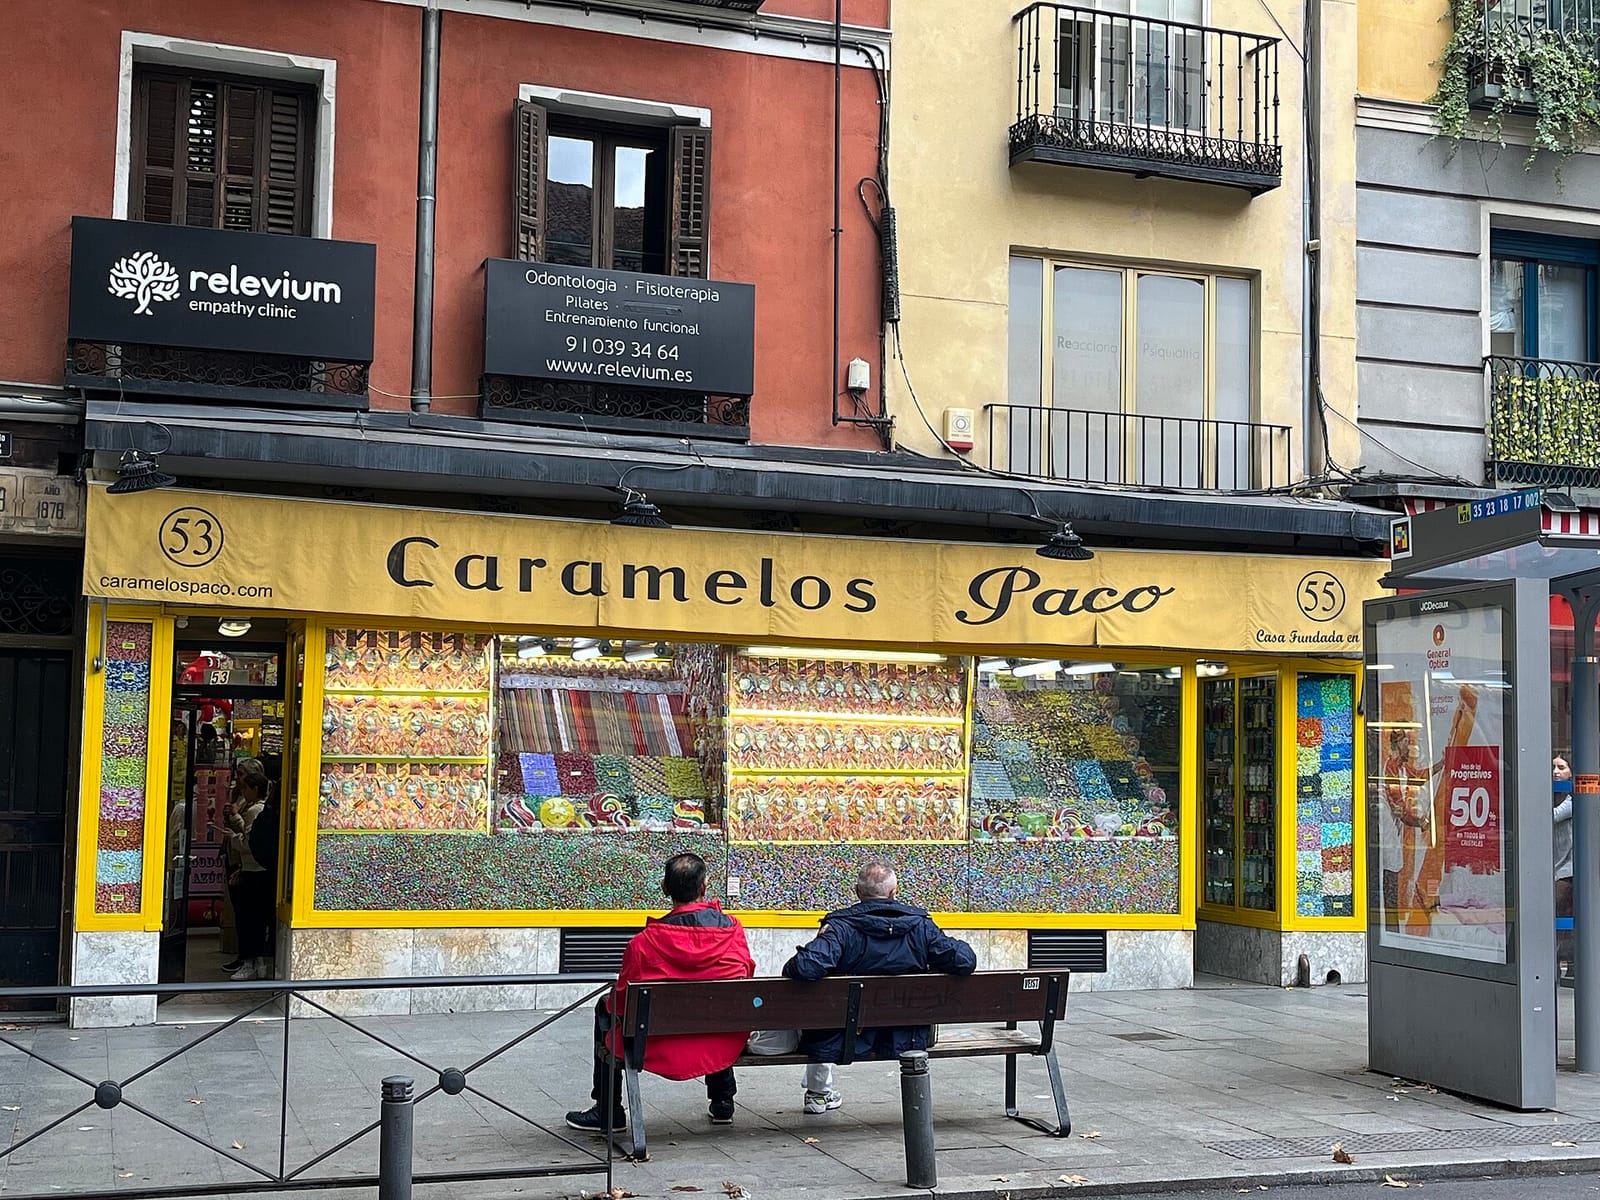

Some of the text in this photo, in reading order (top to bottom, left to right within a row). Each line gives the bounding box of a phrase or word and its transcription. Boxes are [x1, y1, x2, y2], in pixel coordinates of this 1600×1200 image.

[189, 264, 341, 304] relevium
[635, 280, 720, 303] Fisioterapia
[189, 300, 297, 319] empathy clinic
[566, 295, 609, 311] Pilates
[545, 310, 700, 335] Entrenamiento funcional
[631, 341, 652, 358] 34
[657, 344, 679, 361] 64
[546, 358, 693, 383] www.relevium.es
[1473, 492, 1539, 518] 35 23 18 17 002
[168, 517, 213, 555] 53
[99, 576, 273, 598] caramelospaco.com
[386, 536, 1176, 626] Caramelos Paco
[1303, 580, 1336, 612] 55
[1420, 601, 1449, 612] JCDecaux
[1256, 629, 1360, 644] Casa Fundada en
[1426, 647, 1451, 660] General
[211, 671, 228, 684] 53
[1450, 769, 1492, 780] Progresivos
